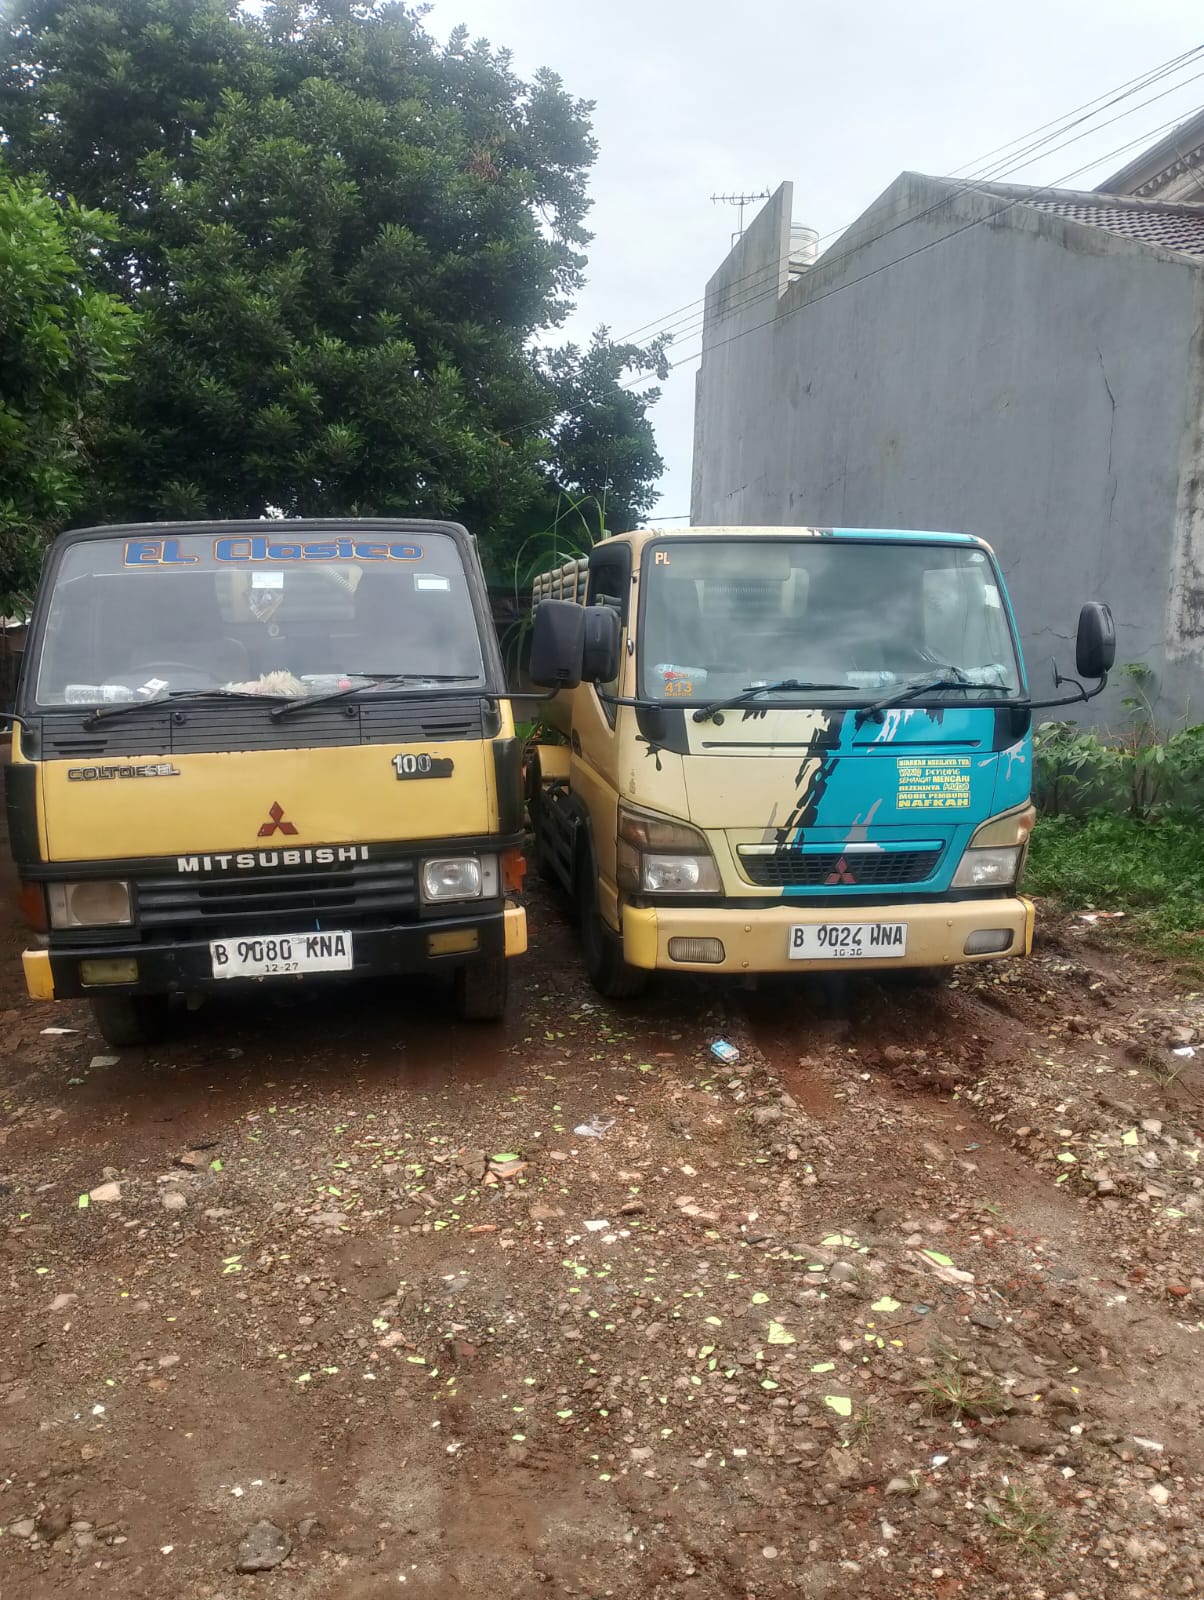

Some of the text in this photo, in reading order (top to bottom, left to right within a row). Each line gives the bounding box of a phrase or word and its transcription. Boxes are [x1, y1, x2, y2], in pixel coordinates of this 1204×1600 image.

[122, 536, 425, 568] EL Clasico
[655, 552, 671, 565] PL
[664, 681, 693, 693] 413
[392, 753, 432, 775] 100
[932, 775, 970, 783] MENCARI
[898, 799, 969, 807] NAFKAH
[177, 845, 370, 873] MITSUBISHI
[793, 924, 903, 948] B 9024 WNA
[214, 935, 346, 965] B 9080 KNA
[265, 962, 299, 973] 12-27
